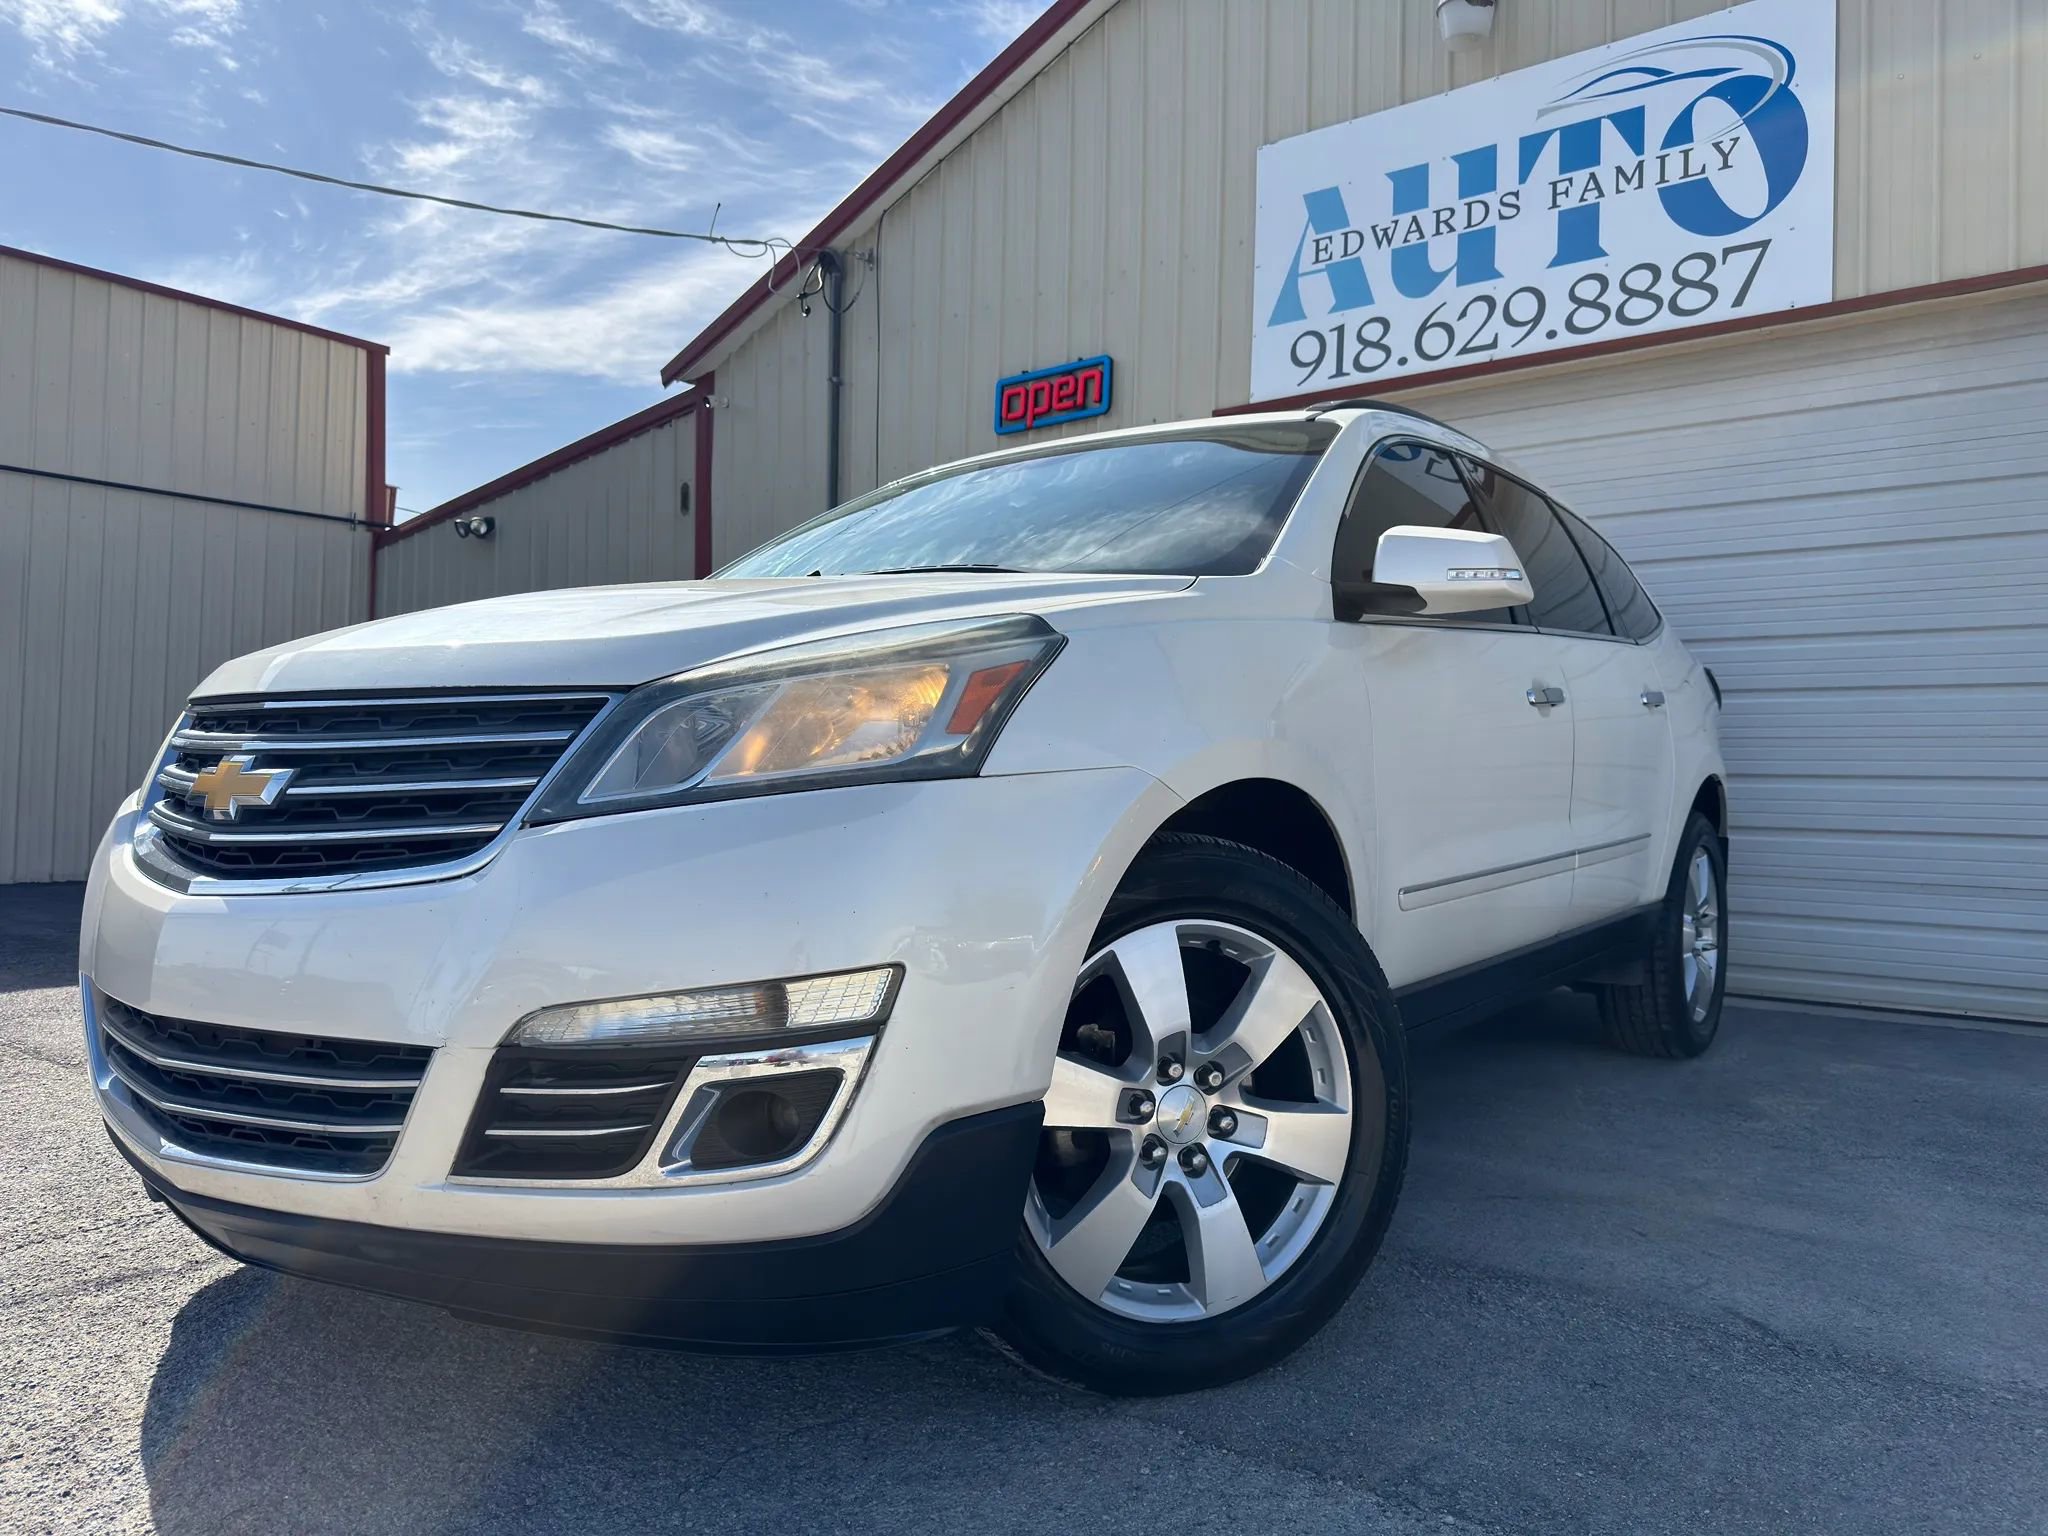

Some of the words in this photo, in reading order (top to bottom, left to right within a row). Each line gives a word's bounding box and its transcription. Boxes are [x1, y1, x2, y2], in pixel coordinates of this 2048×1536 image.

[1311, 189, 1522, 266] EDWARDS
[1547, 136, 1741, 211] FAMILY
[1290, 238, 1773, 388] 918.629.8887
[1001, 367, 1104, 430] open
